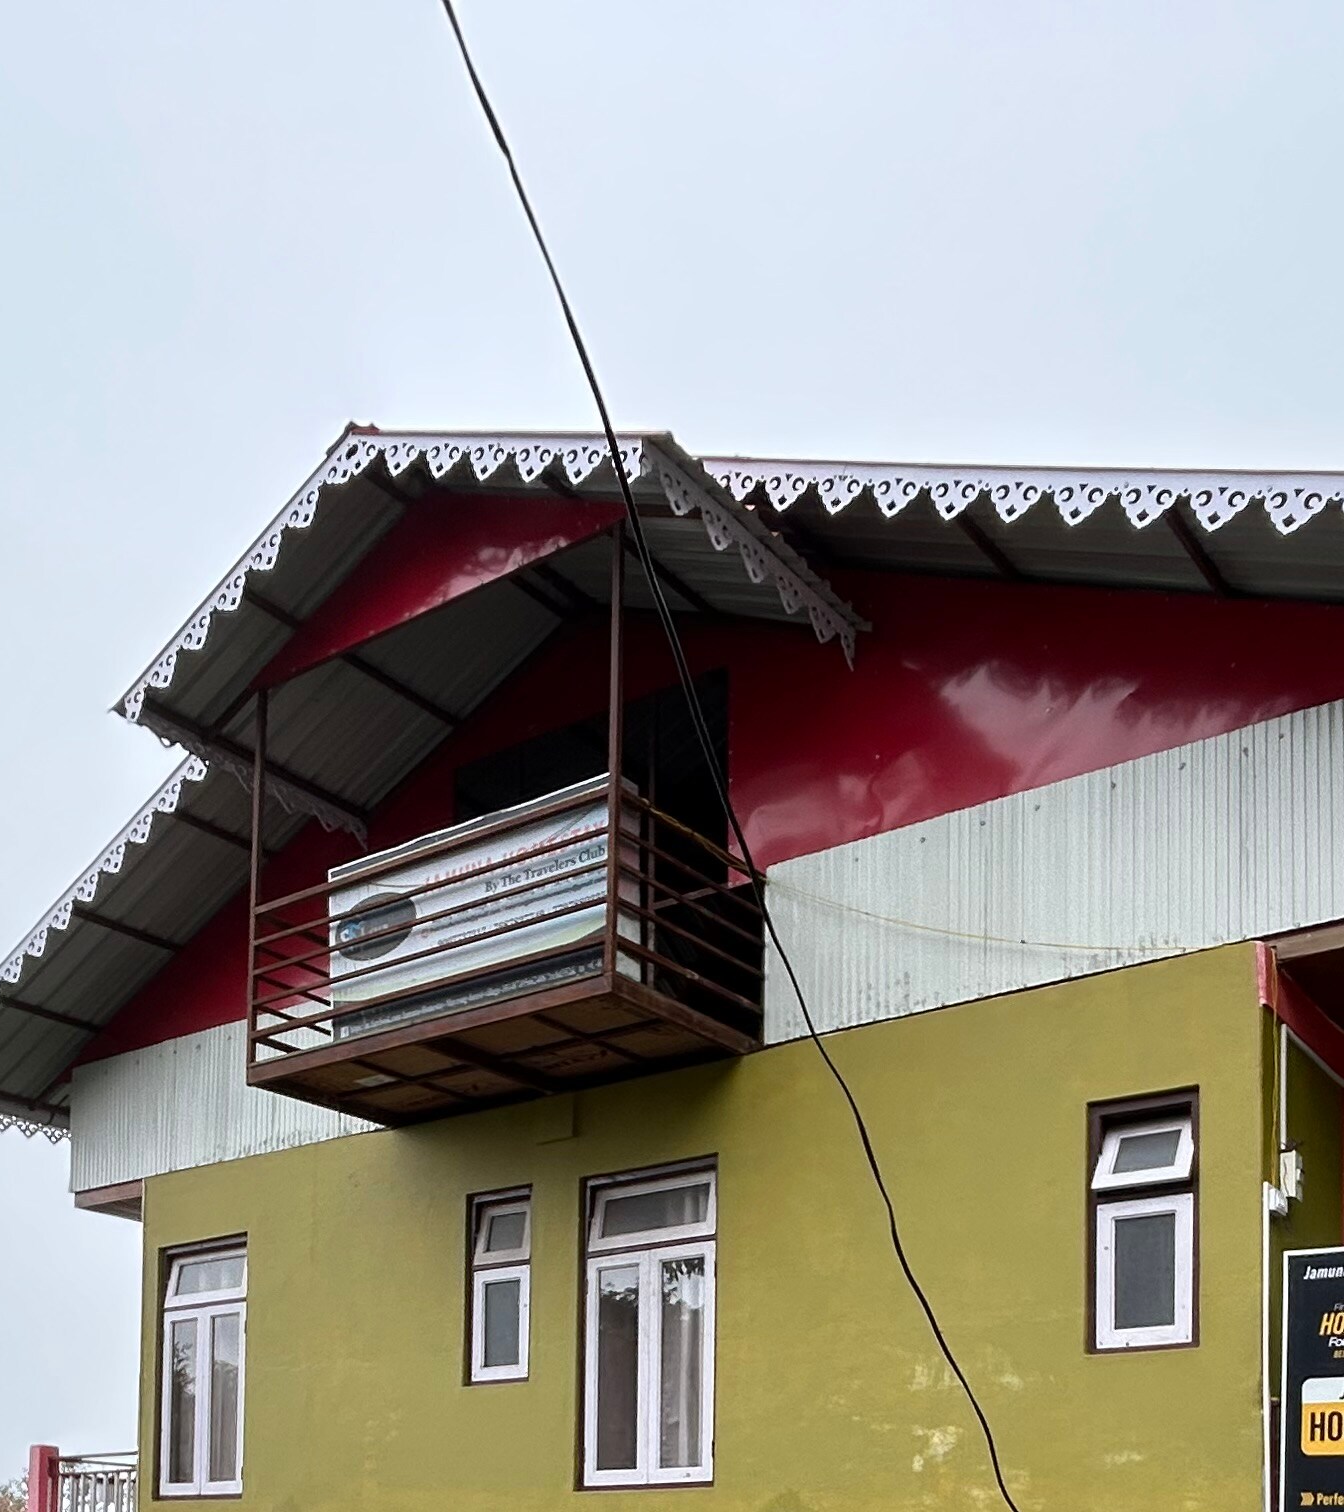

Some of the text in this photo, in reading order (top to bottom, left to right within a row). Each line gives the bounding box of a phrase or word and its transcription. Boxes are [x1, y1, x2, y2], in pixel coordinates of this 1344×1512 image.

[484, 846, 606, 894] By The Travelers Club
